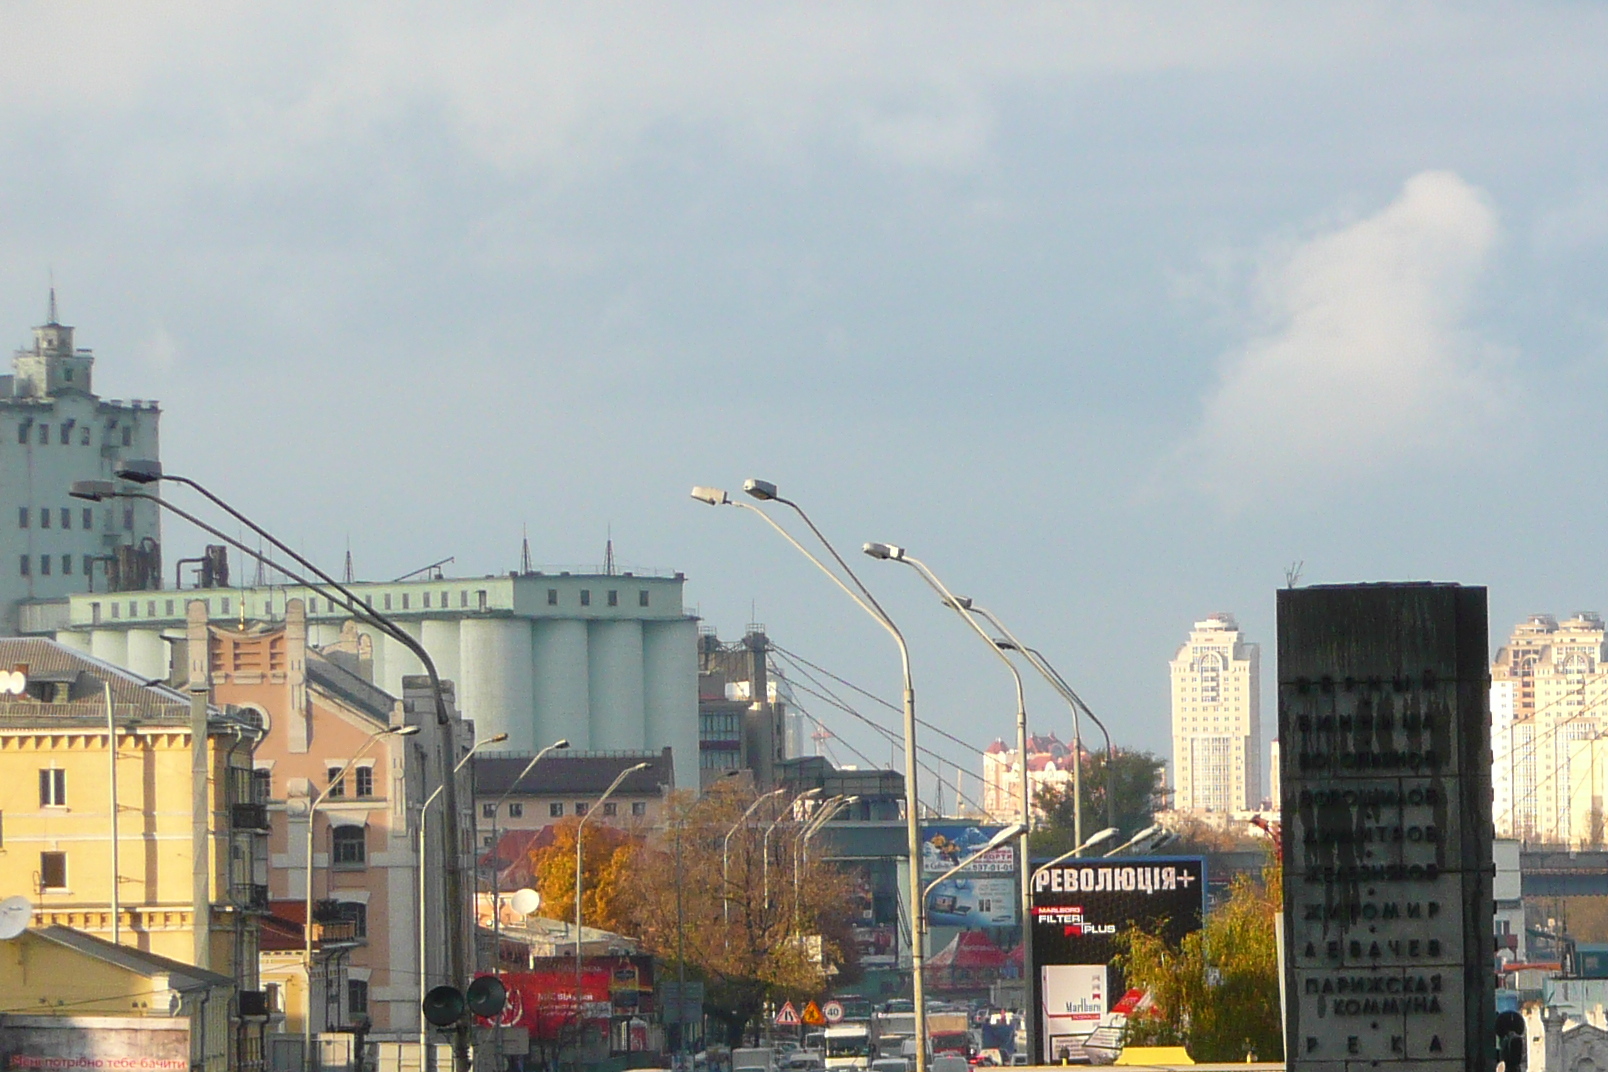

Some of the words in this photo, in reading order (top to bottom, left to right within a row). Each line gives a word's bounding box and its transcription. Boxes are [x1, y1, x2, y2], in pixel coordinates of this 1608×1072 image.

[1036, 868, 1195, 894] РЕВОЛЮЦІЯ+
[1038, 914, 1081, 923] FILTER
[1304, 901, 1440, 920] ЖИТОМИР
[1084, 925, 1116, 934] PLUS
[1304, 938, 1441, 958] ЛЕВАЧЕВ
[1305, 973, 1442, 995] ПАРИЖСКАЯ
[827, 1008, 839, 1016] 40
[1334, 995, 1443, 1015] КОММУНА
[1306, 1034, 1443, 1054] РЕКА
[45, 1056, 104, 1070] потрібно
[107, 1058, 136, 1068] тебе
[140, 1057, 187, 1070] бачити
